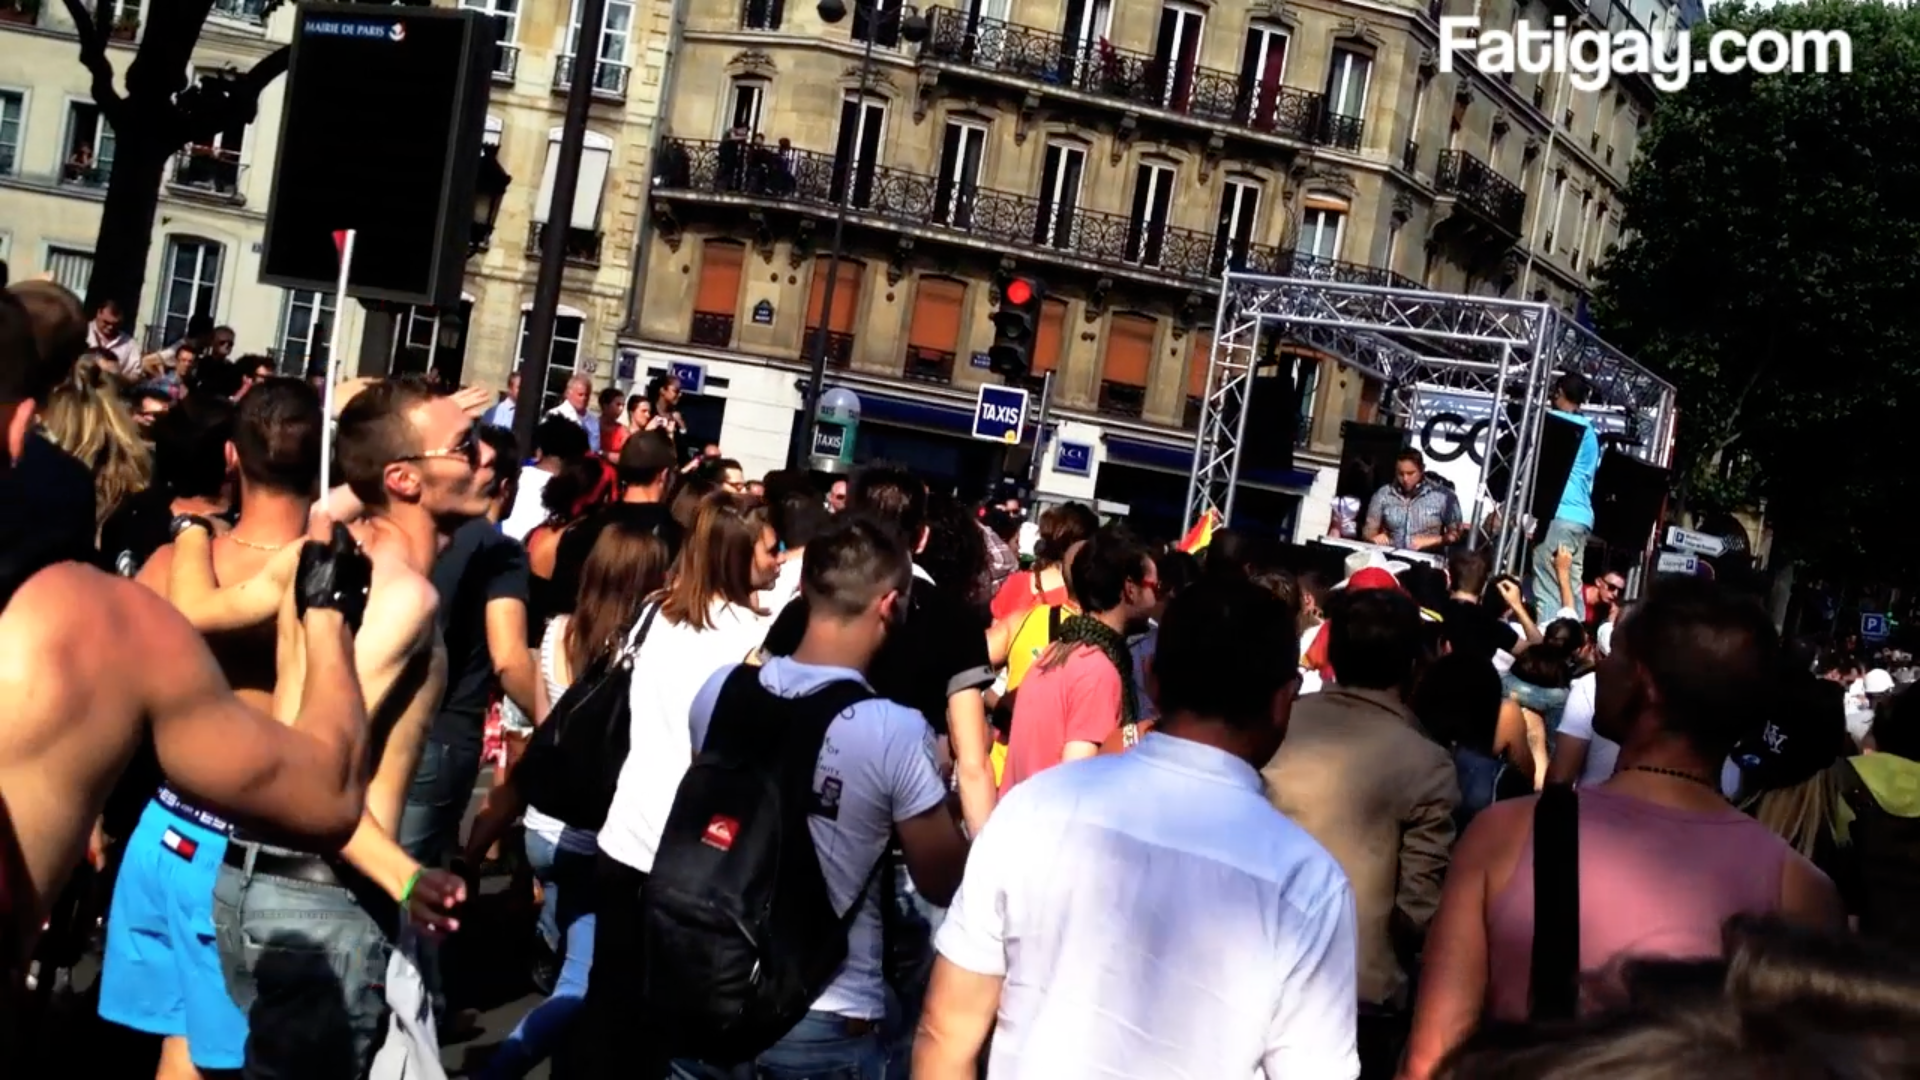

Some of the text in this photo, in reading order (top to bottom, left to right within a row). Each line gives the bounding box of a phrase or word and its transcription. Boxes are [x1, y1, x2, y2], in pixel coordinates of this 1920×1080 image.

[304, 21, 385, 37] MAIRIE DE PARIS
[981, 402, 1020, 425] TAXIS
[817, 432, 841, 449] TAXIS
[1867, 617, 1878, 631] P
[1763, 719, 1788, 754] NY
